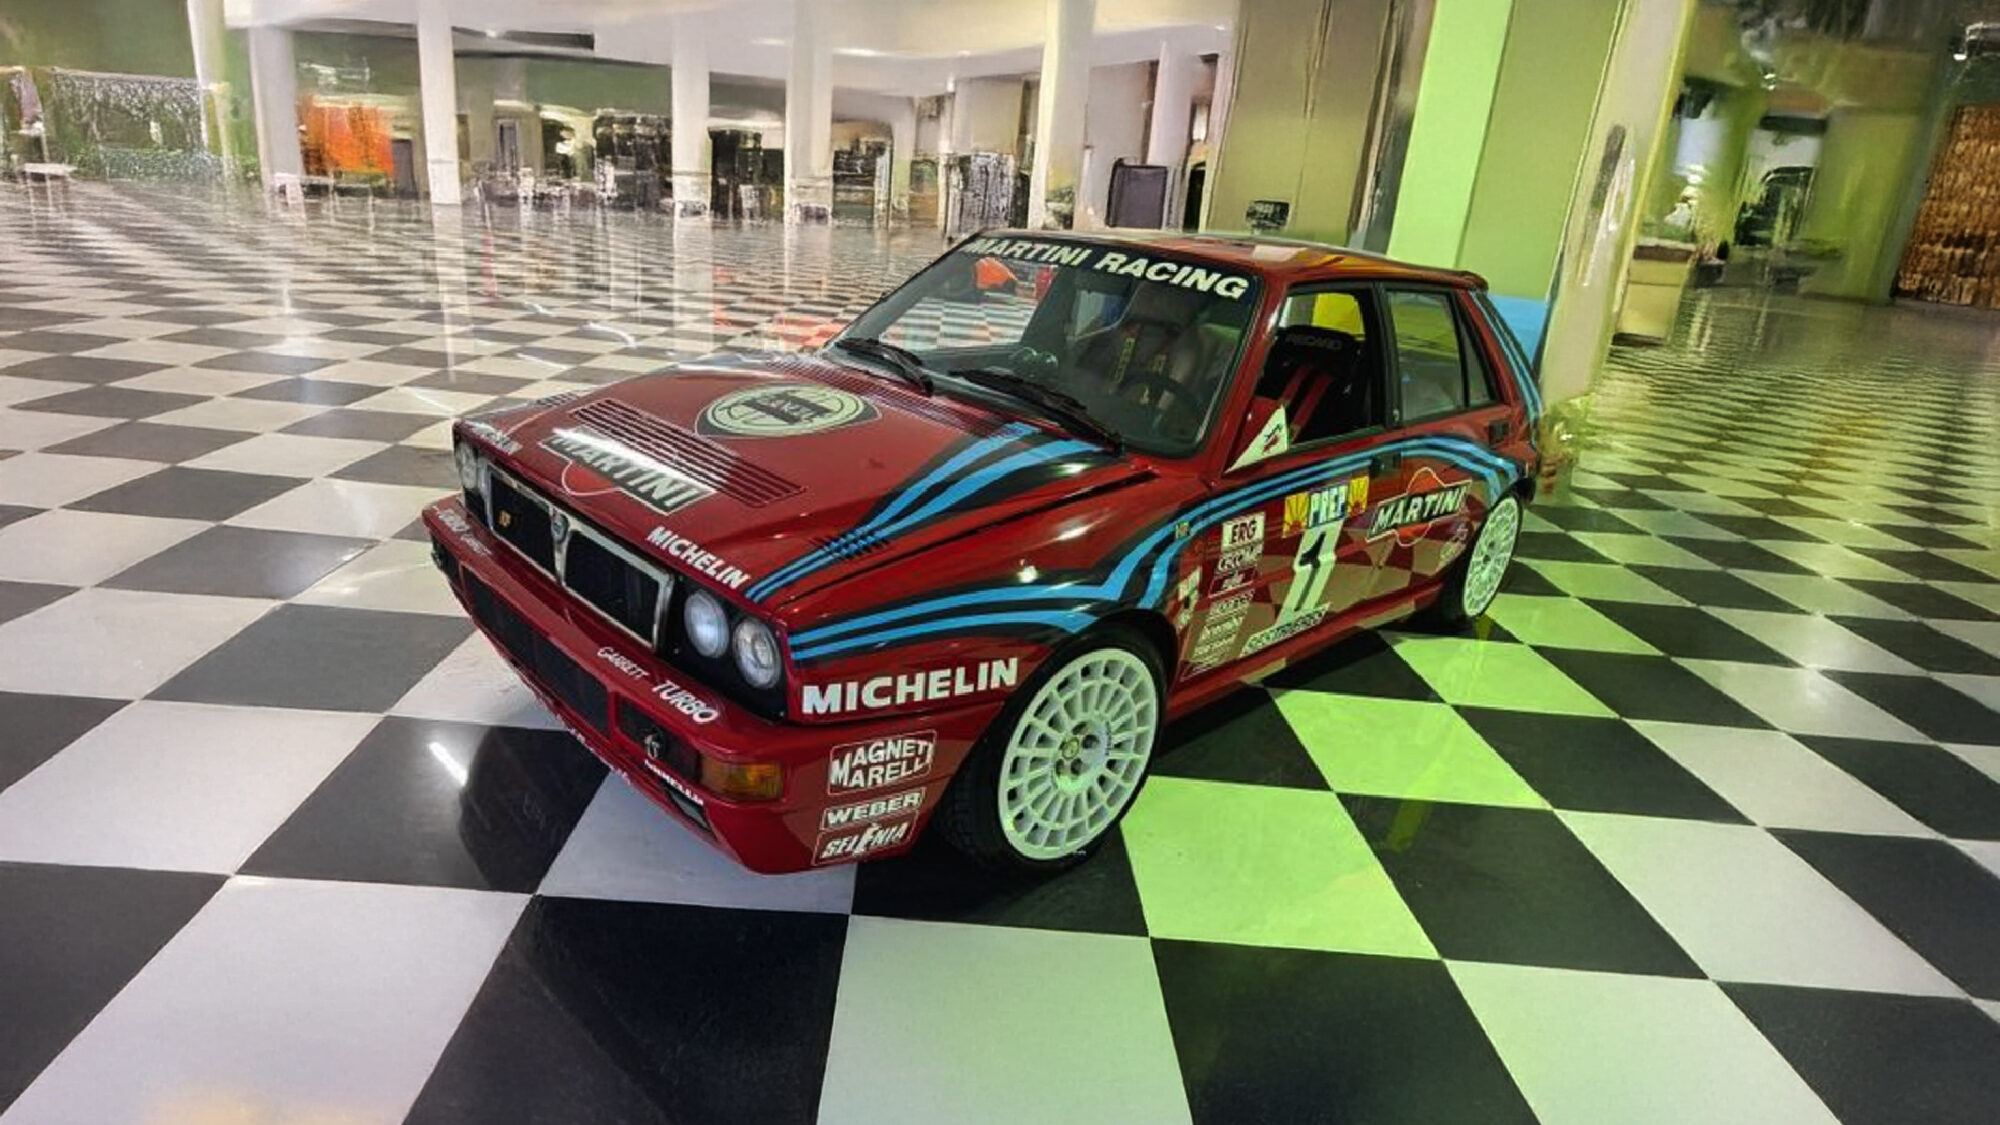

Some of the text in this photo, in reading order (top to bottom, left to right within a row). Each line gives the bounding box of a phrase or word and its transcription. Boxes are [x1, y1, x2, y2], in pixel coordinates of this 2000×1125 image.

[967, 238, 1249, 300] MARTINI RACING
[551, 432, 700, 507] MARTINI
[1372, 484, 1468, 533] MARTINI
[647, 526, 750, 590] MICHELIN
[652, 680, 719, 724] TURBO
[801, 657, 1019, 715] MICHELIN
[827, 792, 921, 824] WEBER
